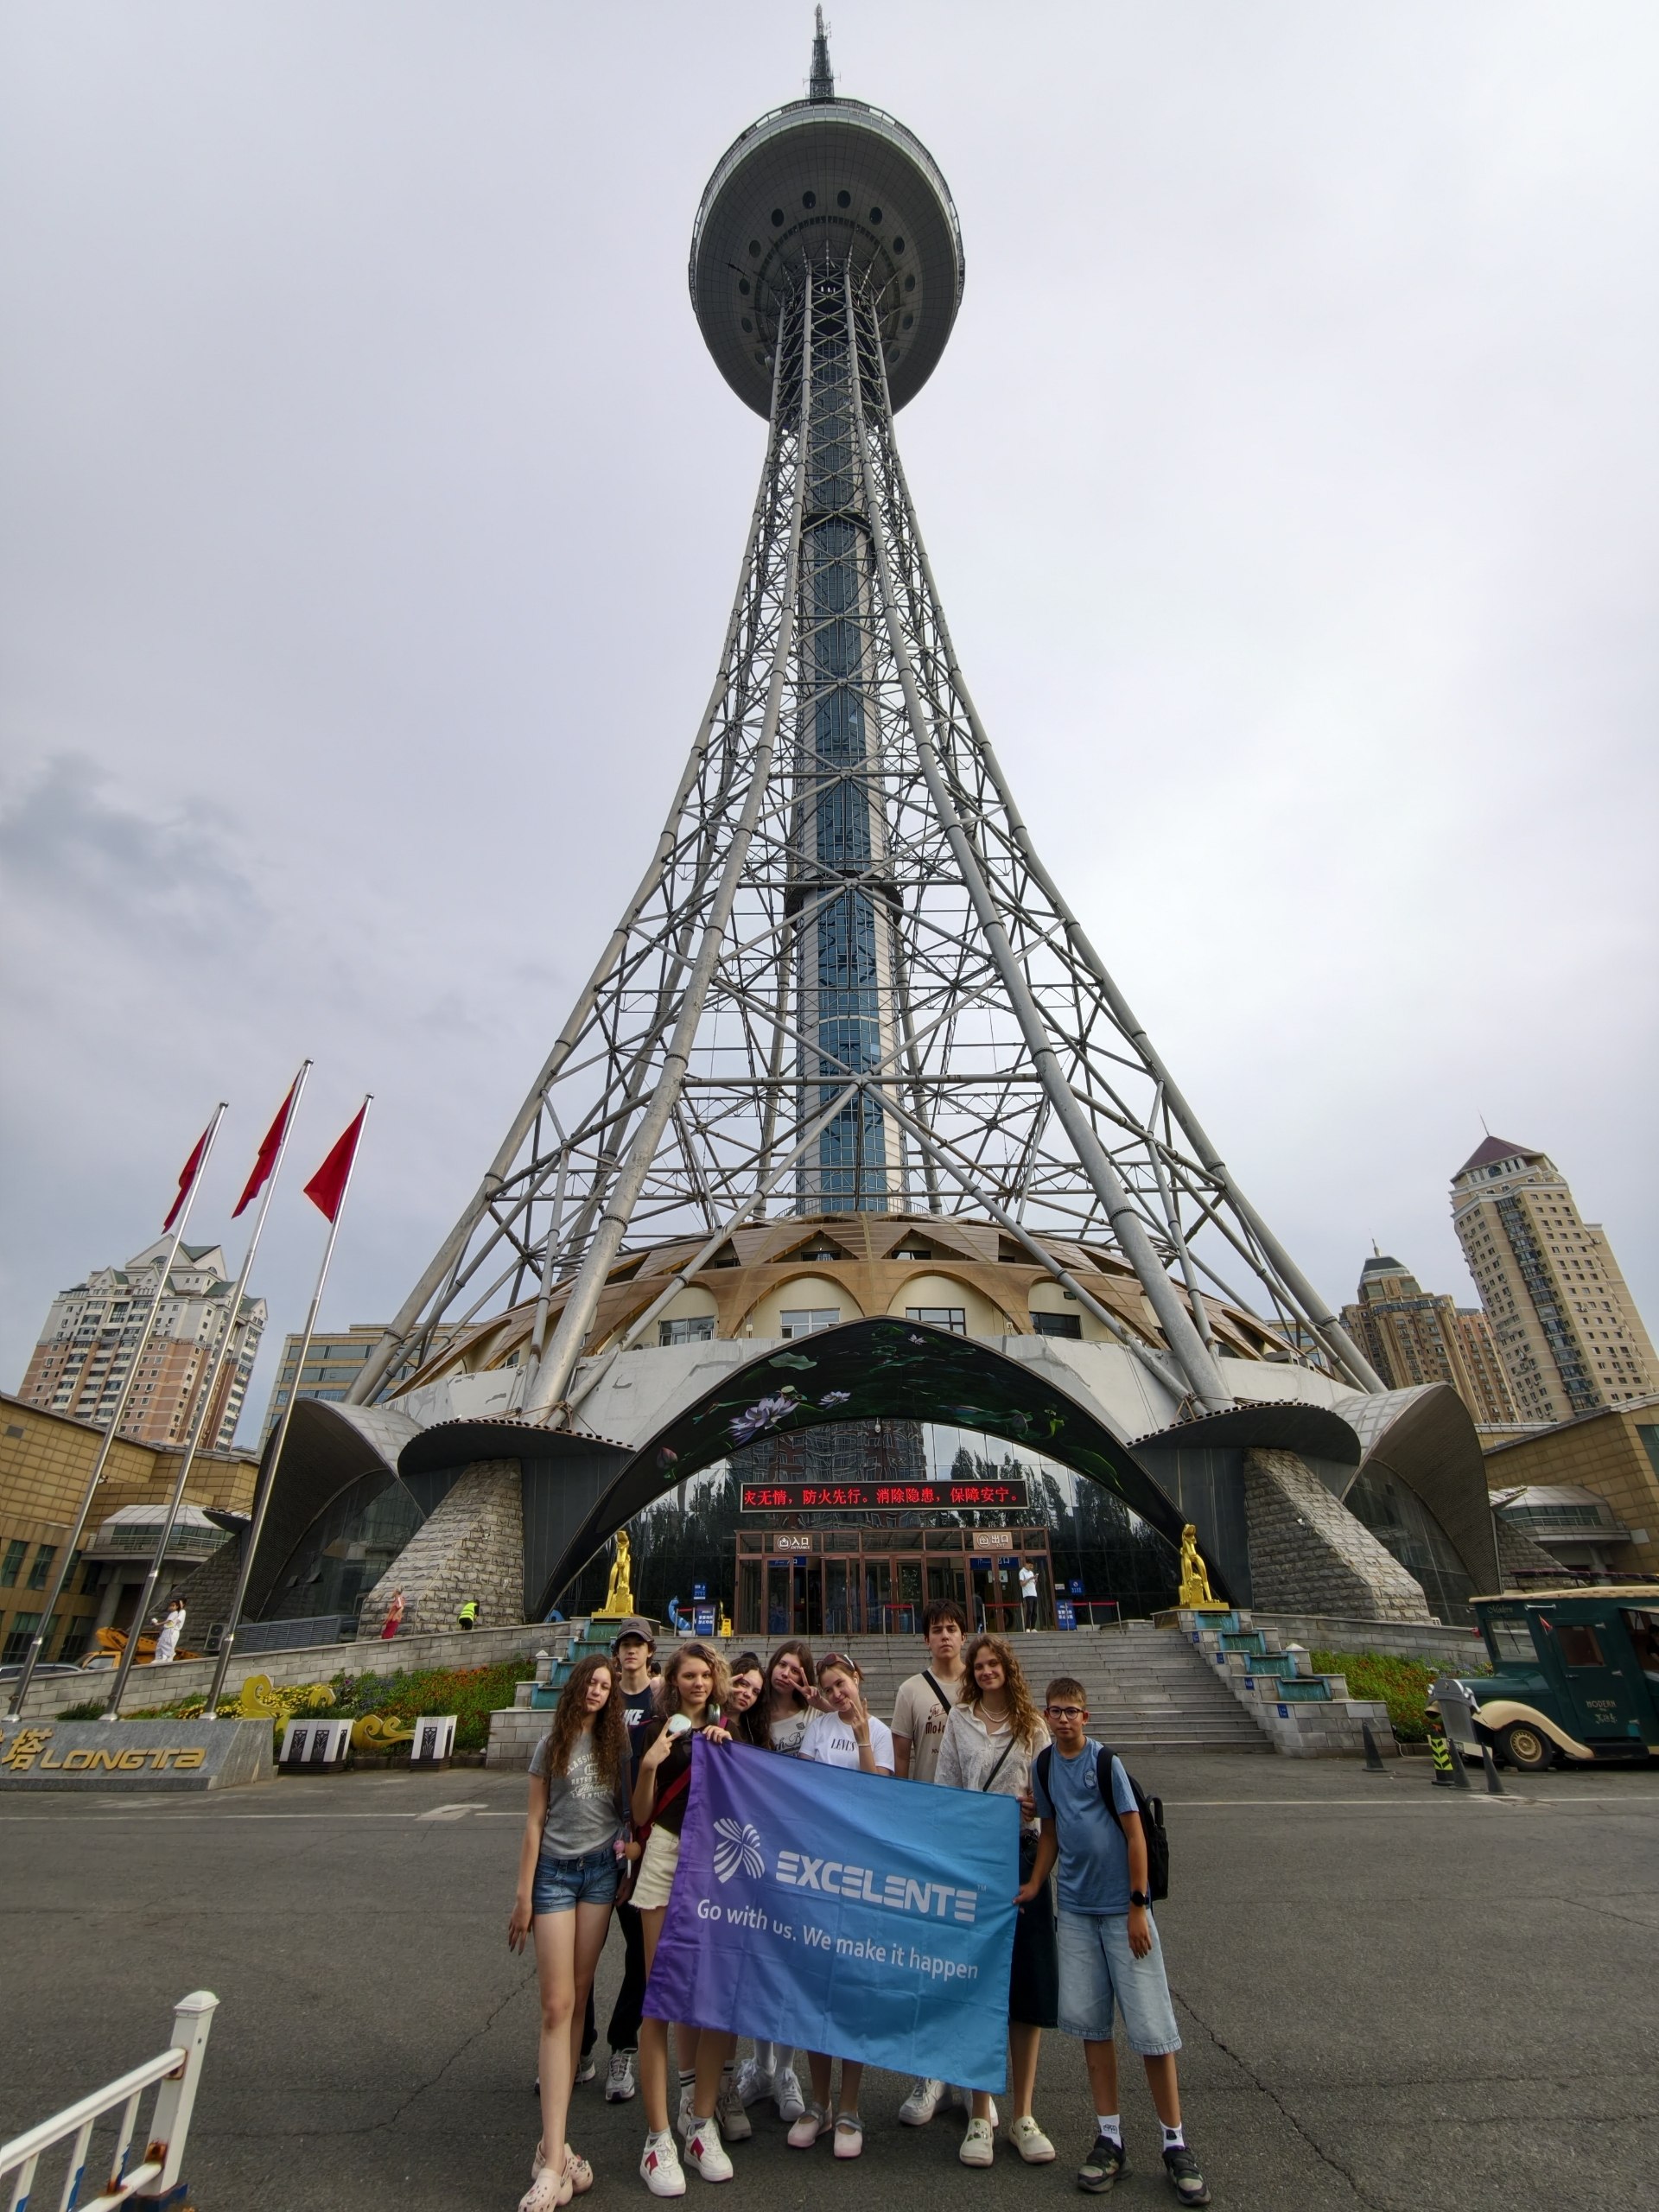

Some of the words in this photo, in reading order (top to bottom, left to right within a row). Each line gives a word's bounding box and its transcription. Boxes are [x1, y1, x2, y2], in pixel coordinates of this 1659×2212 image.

[791, 1536, 809, 1546] 入口
[991, 1534, 1008, 1544] 出口
[1586, 1700, 1617, 1708] MODERN
[624, 1708, 645, 1726] IKE
[0, 1727, 54, 1770] 塔
[776, 1850, 977, 1923] EXCELENTE
[697, 1899, 721, 1920] Go
[727, 1905, 767, 1930] with
[773, 1920, 797, 1941] us.
[804, 1925, 831, 1950] We
[836, 1938, 887, 1962] make
[891, 1943, 905, 1967] it
[910, 1947, 978, 1981] happen
